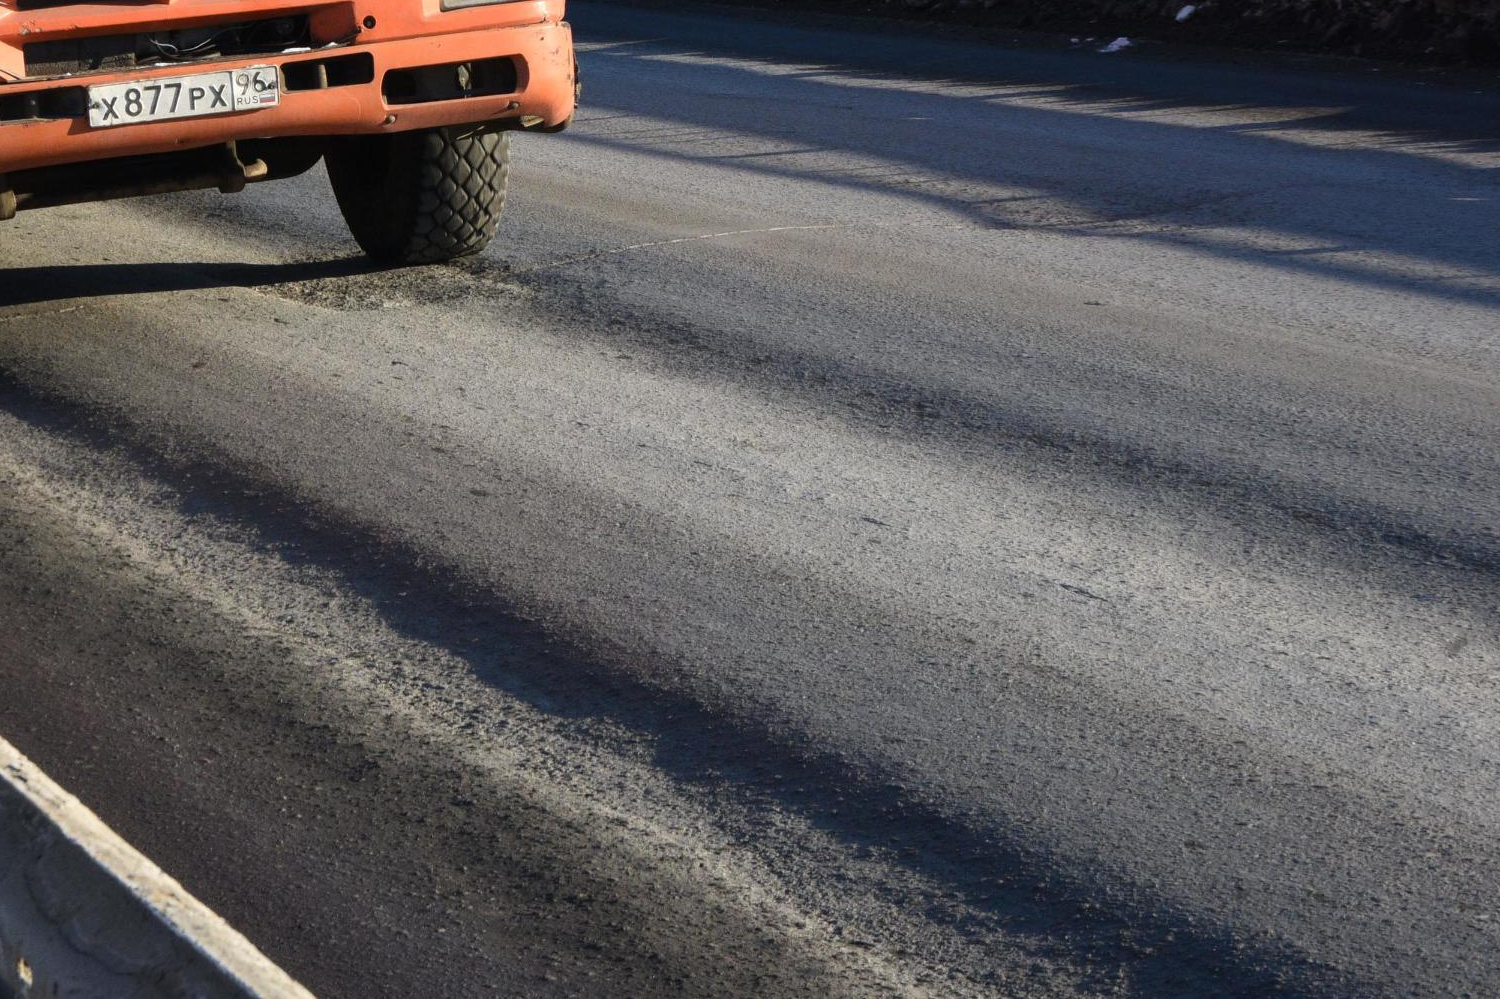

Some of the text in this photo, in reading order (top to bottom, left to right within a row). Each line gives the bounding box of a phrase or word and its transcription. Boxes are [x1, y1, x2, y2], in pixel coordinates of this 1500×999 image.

[101, 71, 268, 121] Х877РХ 96
[236, 95, 259, 106] RUS
